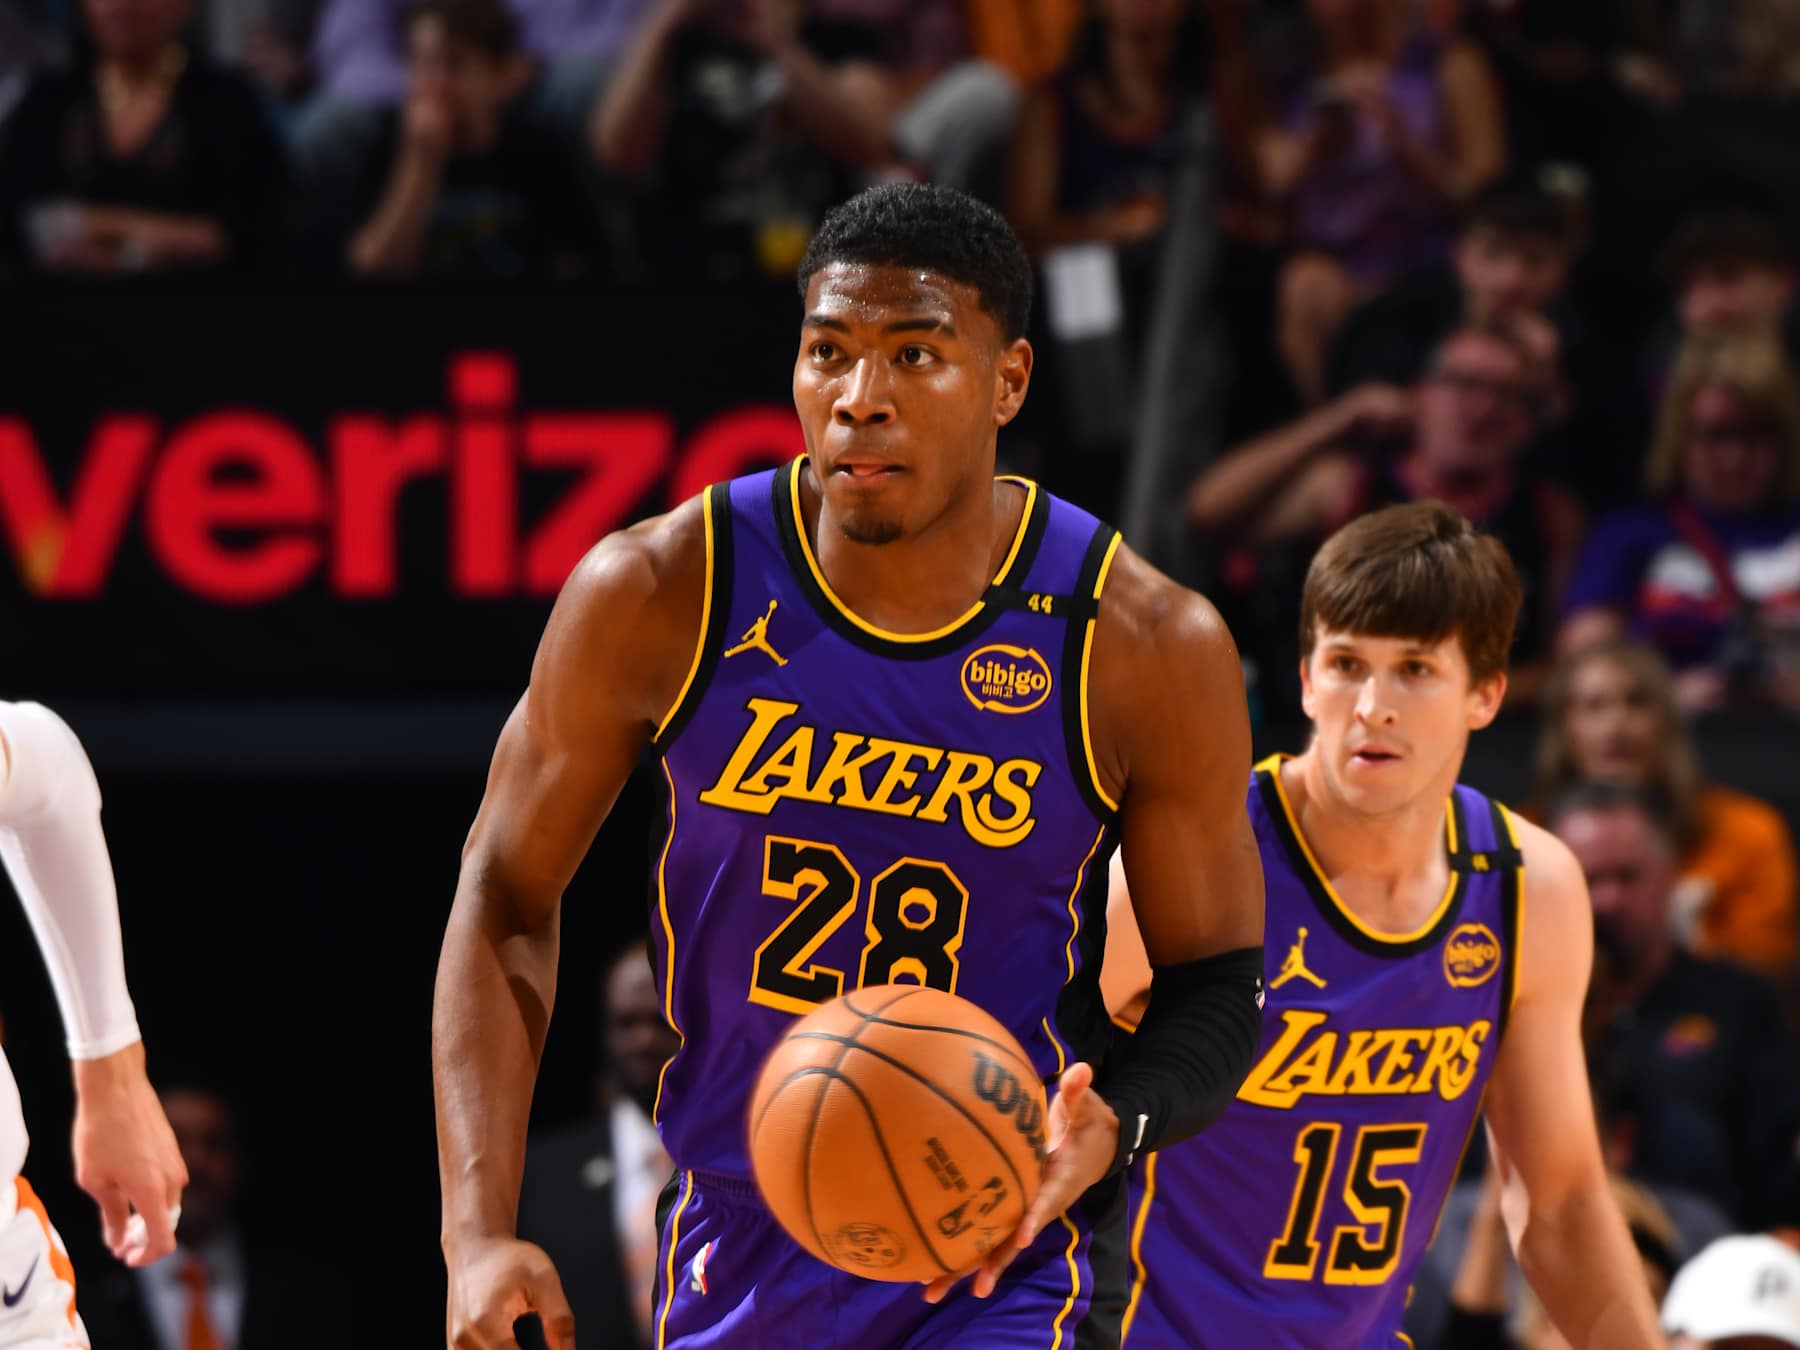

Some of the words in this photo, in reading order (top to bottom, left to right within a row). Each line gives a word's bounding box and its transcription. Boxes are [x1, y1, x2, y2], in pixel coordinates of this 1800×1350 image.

[1028, 593, 1054, 614] 44
[970, 660, 1046, 695] bibigo
[699, 696, 1043, 848] LAKERS
[747, 834, 970, 1016] 28
[1235, 1009, 1493, 1110] LAKERS
[1263, 1121, 1429, 1286] 15
